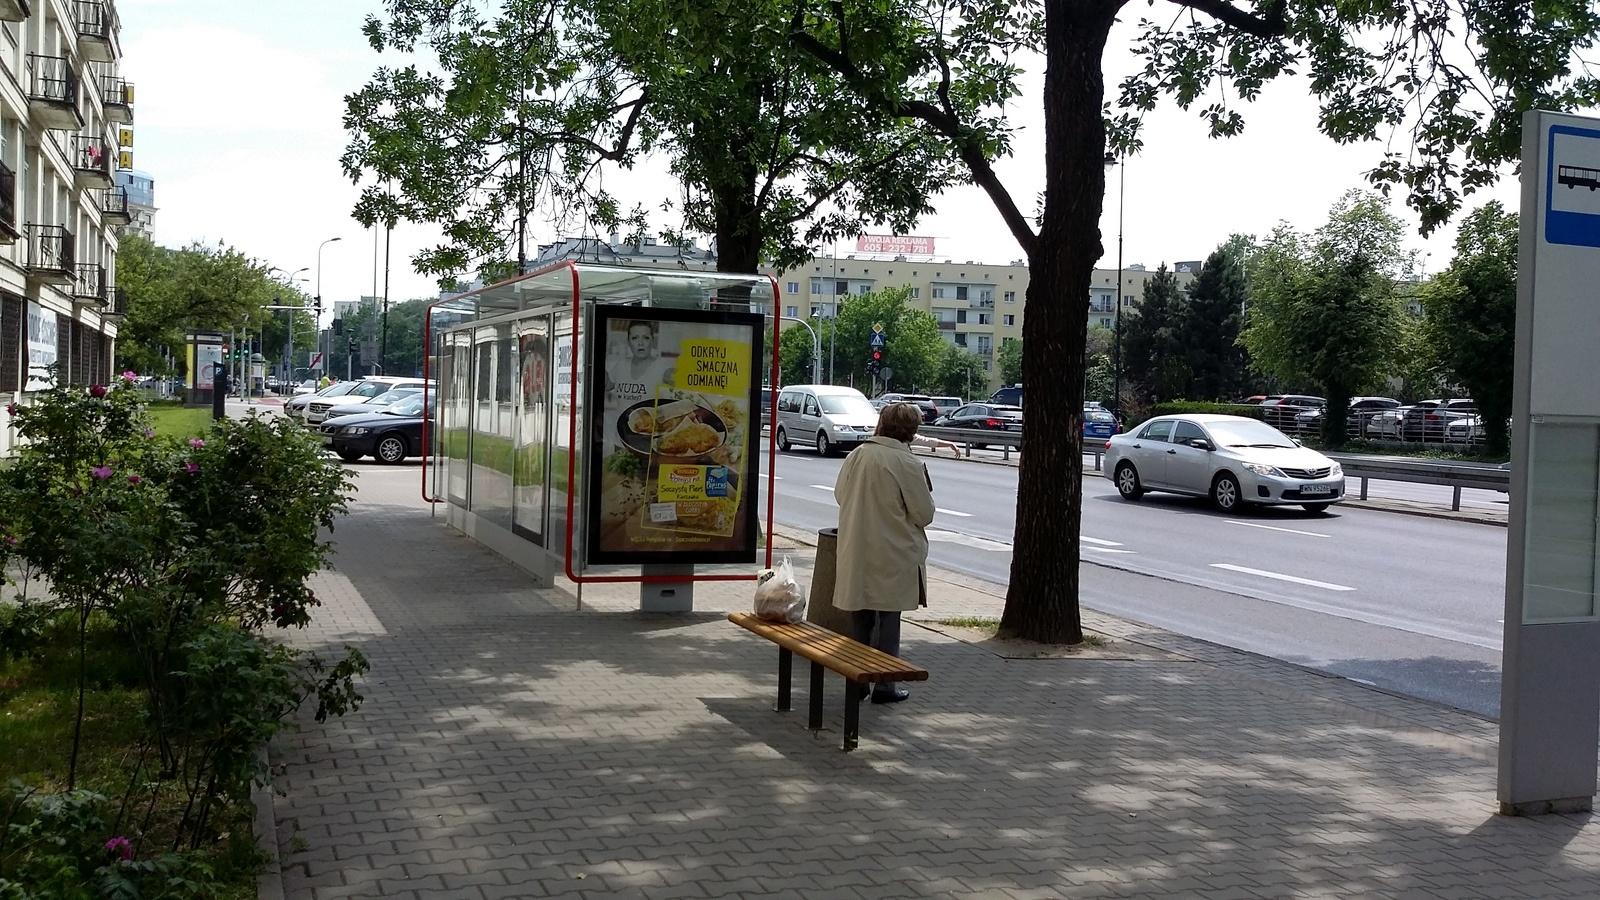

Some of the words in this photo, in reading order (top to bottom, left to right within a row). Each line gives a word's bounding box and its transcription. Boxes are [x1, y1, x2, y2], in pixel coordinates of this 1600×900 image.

[864, 235, 890, 244] TWOJA
[892, 236, 928, 245] REKLAMA
[864, 243, 881, 251] 605
[889, 244, 905, 252] 232
[690, 345, 727, 359] ODKRYJ
[215, 366, 222, 375] P
[696, 360, 739, 376] SMACZNĄ
[687, 373, 729, 389] ODMIANĘ!
[616, 382, 647, 395] NUDA
